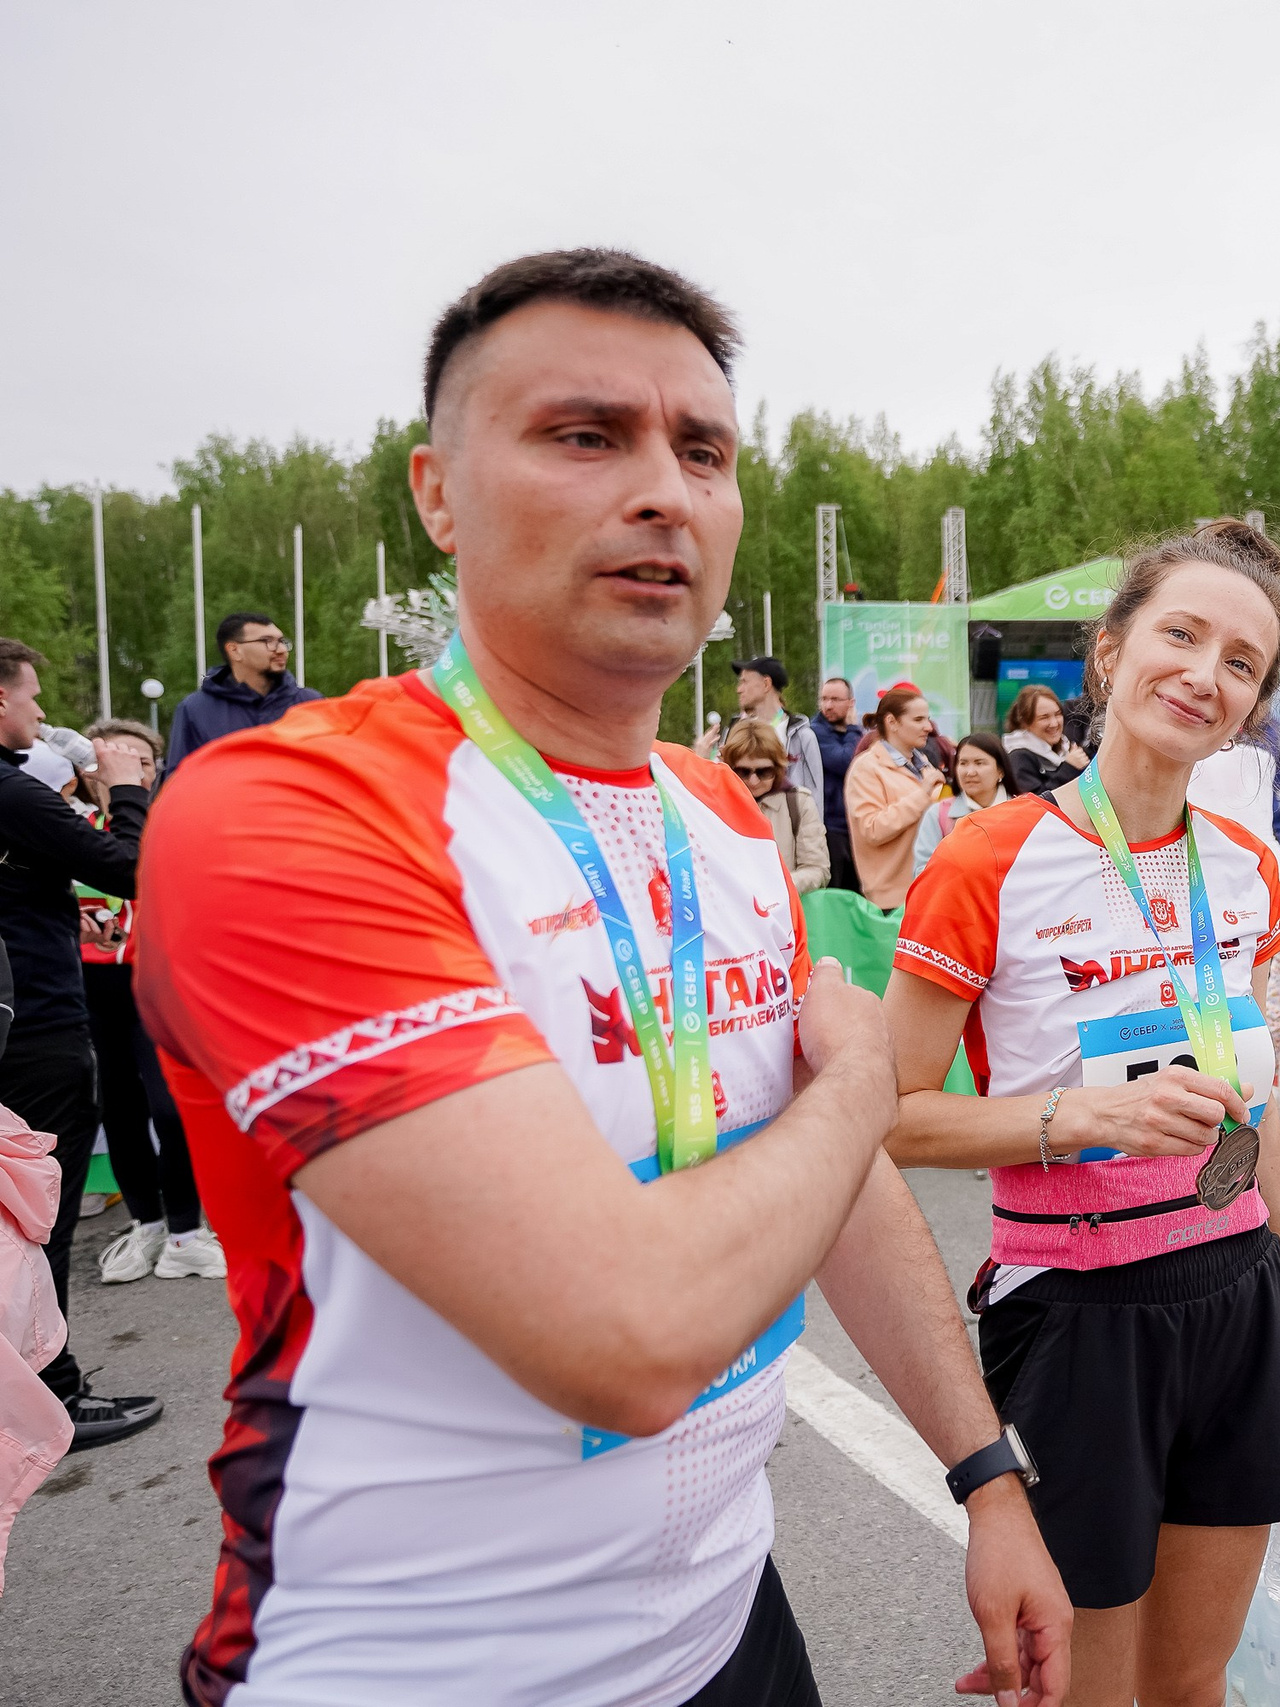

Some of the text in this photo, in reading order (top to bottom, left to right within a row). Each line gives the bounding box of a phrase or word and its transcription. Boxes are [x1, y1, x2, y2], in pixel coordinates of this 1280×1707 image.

[869, 631, 950, 653] ритме
[453, 680, 477, 708] 185
[1091, 792, 1110, 828] 185 лет
[583, 862, 607, 899] Utair
[683, 868, 694, 900] Utair
[1198, 911, 1207, 931] Utair
[625, 964, 650, 1016] СБЕР
[684, 959, 698, 1009] СБЕР
[1204, 964, 1215, 991] СБЕР
[1133, 1025, 1158, 1036] СБЕР
[1215, 1019, 1224, 1039] лет
[1216, 1040, 1225, 1060] 185
[690, 1055, 700, 1090] лет
[688, 1092, 702, 1125] 185
